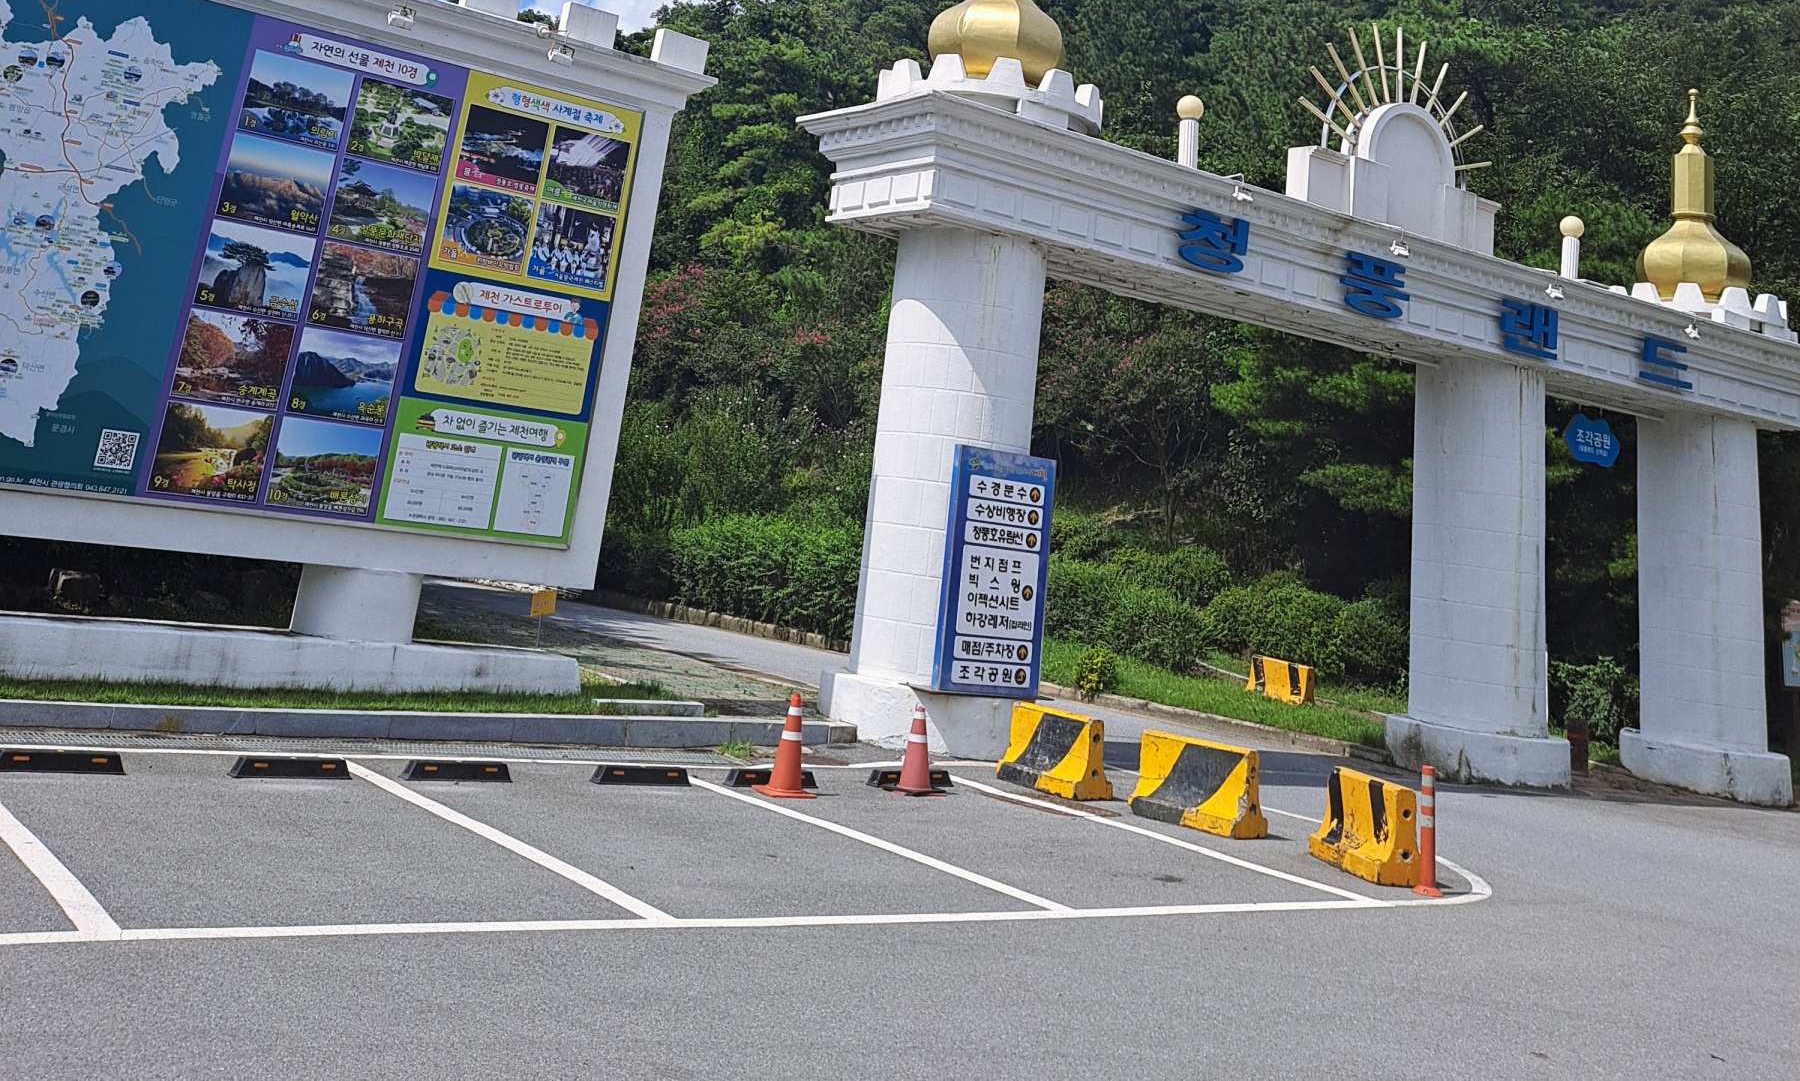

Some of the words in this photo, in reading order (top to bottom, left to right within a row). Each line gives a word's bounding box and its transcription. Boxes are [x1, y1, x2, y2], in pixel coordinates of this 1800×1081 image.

[311, 41, 345, 59] 자연의
[348, 51, 370, 67] 선물
[372, 57, 395, 73] 제천
[397, 64, 418, 79] 10경
[512, 92, 551, 113] 형형색색
[553, 103, 581, 120] 사계절
[584, 112, 603, 125] 축제
[245, 117, 257, 128] 1경
[351, 140, 364, 152] 2경
[221, 201, 237, 214] 3경
[290, 209, 319, 224] 월악산
[331, 223, 346, 235] 4경
[360, 224, 423, 245] 청풍문화재단지
[200, 289, 215, 303] 5경
[269, 296, 298, 311] 금수산
[479, 289, 500, 305] 제천
[1176, 208, 1693, 390] 청풍랜드
[311, 310, 326, 321] 6경
[368, 314, 403, 329] 용하구곡
[177, 381, 192, 394] 7경
[238, 385, 278, 400] 송계계곡
[291, 397, 305, 410] 8경
[357, 401, 385, 416] 옥순봉
[442, 415, 453, 427] 차
[455, 416, 476, 431] 없이
[478, 420, 508, 435] 즐기는
[508, 424, 549, 442] 제천여행
[1575, 429, 1611, 449] 조각공원
[153, 476, 169, 488] 9경
[227, 478, 256, 492] 탁사정
[268, 489, 288, 503] 10경
[977, 480, 1027, 500] 수경분수
[330, 490, 368, 506] 배론성지
[974, 502, 1026, 523] 수상비행장
[972, 526, 1024, 546] 청풍호유람선
[970, 554, 1022, 574] 번지점프
[967, 592, 1020, 610] 이젝션시트
[961, 640, 1015, 659] 매점/주차장
[958, 665, 1013, 683] 조각공원
